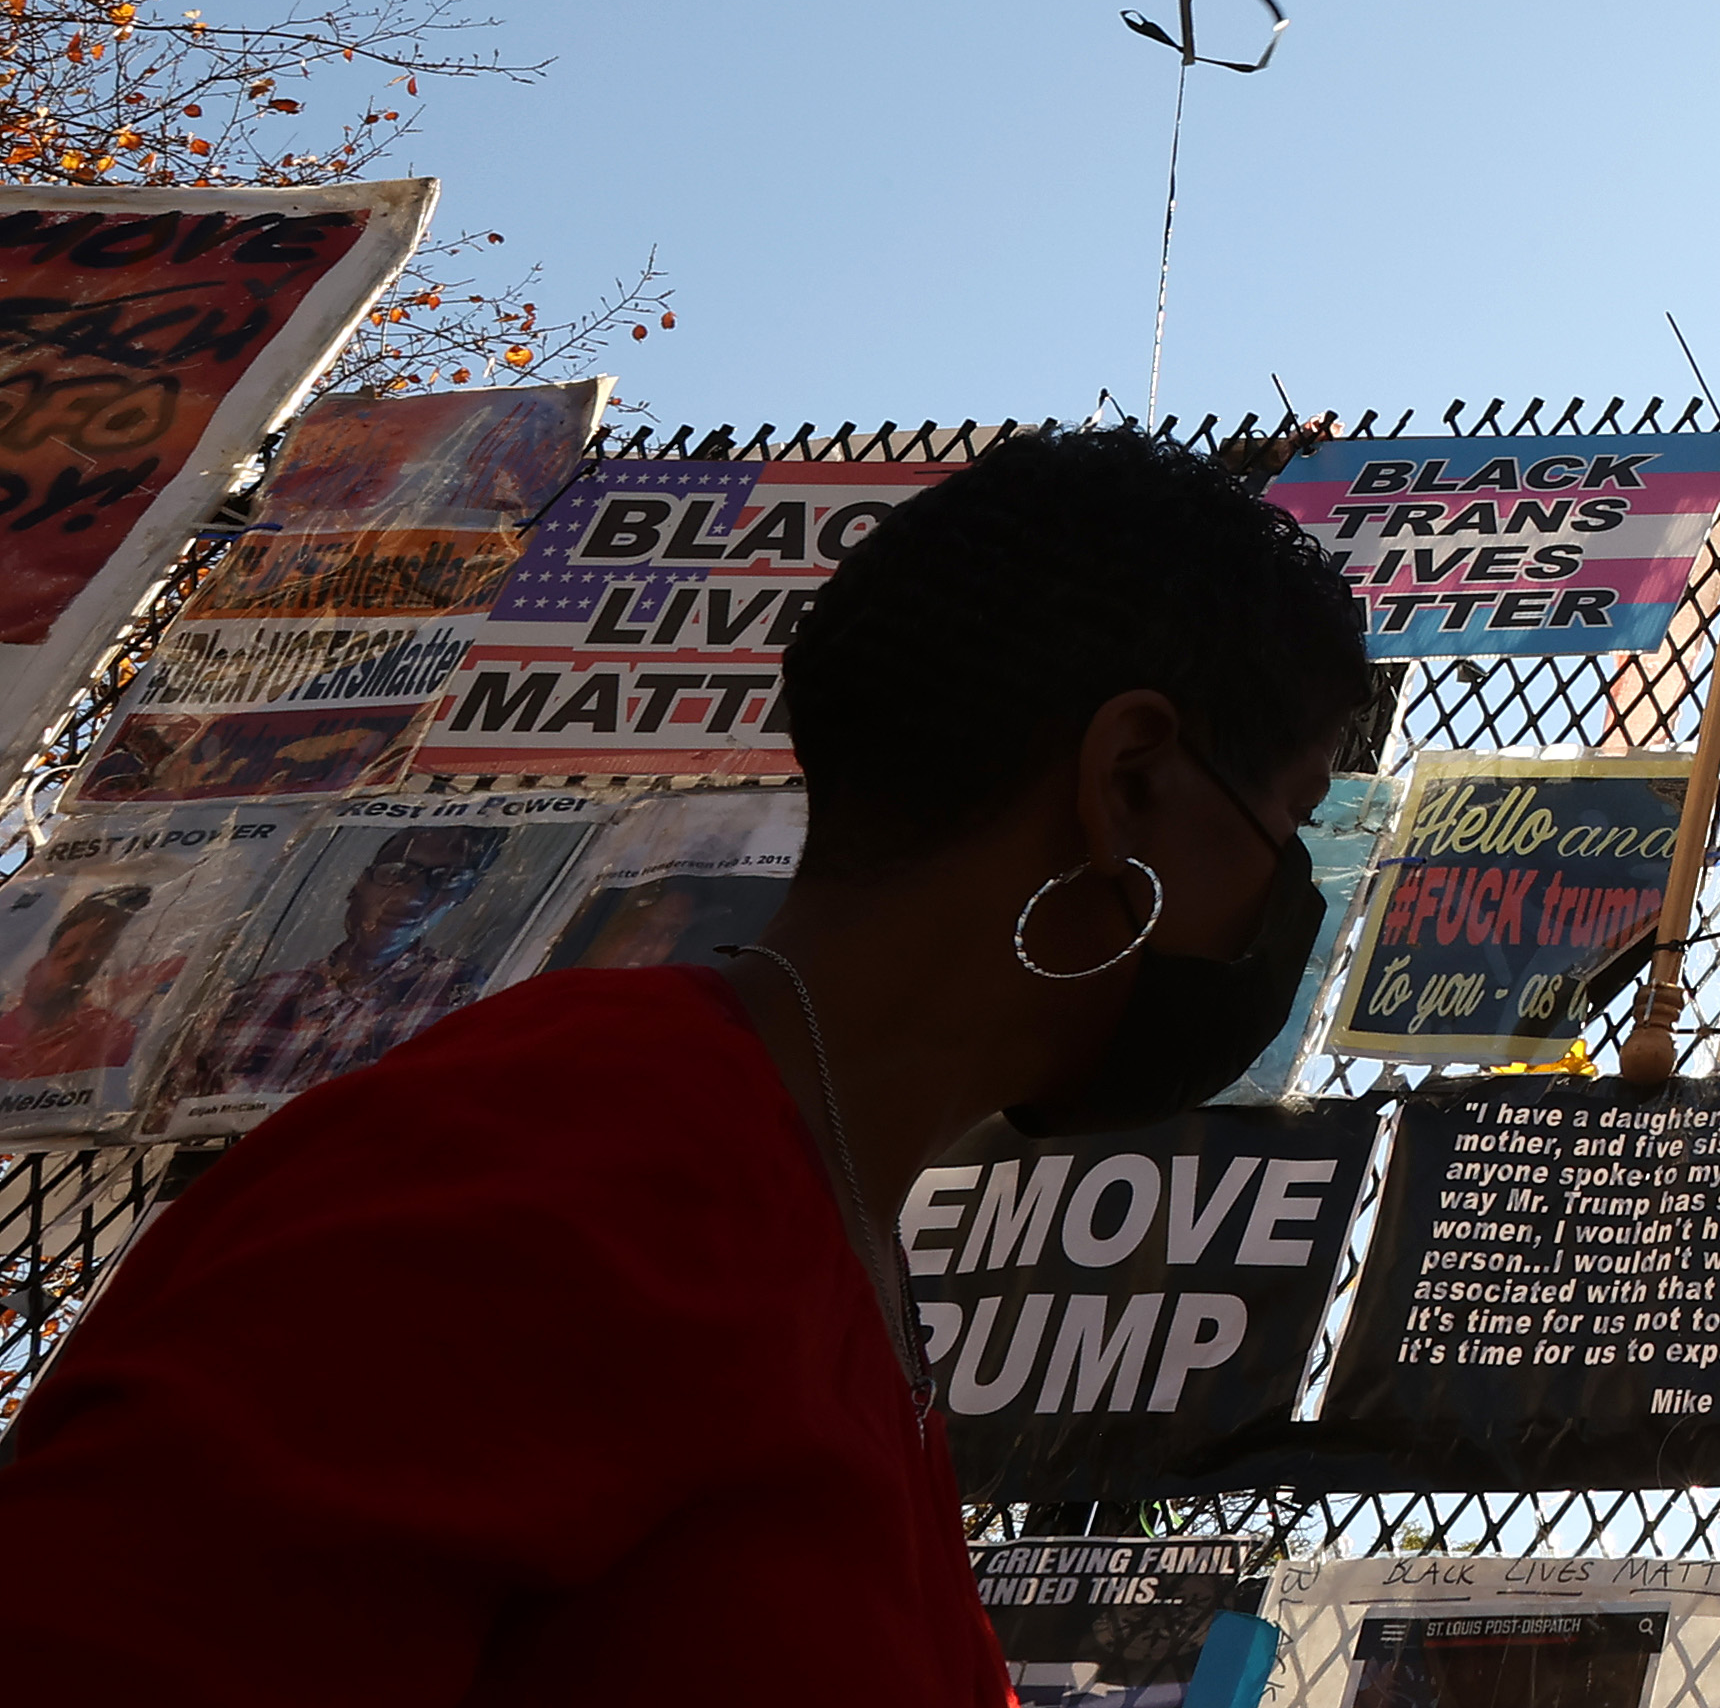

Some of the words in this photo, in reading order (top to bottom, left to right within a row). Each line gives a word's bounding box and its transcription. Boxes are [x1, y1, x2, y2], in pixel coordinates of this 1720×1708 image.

[1346, 453, 1663, 497] BLACK
[580, 498, 899, 562] BLAC
[1328, 497, 1632, 539] TRANS
[1333, 543, 1584, 585] LIVES
[1363, 589, 1620, 635] ATTER
[1413, 783, 1558, 861] Hello
[1384, 865, 1539, 948] #FUCK
[1369, 955, 1411, 1016] to
[1407, 972, 1487, 1035] you
[900, 1154, 1340, 1277] EMOVE
[1439, 1188, 1497, 1215] way
[1506, 1188, 1549, 1213] Mr.
[1563, 1191, 1650, 1220] Trump
[1659, 1188, 1705, 1213] has
[1431, 1218, 1542, 1248] women,
[1553, 1219, 1564, 1244] I
[1575, 1217, 1692, 1246] wouldn't
[1414, 1278, 1576, 1304] associated
[1586, 1277, 1648, 1304] with
[1656, 1275, 1716, 1301] that
[1651, 1387, 1713, 1414] Mike
[986, 1547, 1133, 1575] GRIEVING
[1383, 1560, 1475, 1588] BLACK
[1505, 1559, 1595, 1585] LIVES
[1088, 1578, 1182, 1606] THIS...
[1426, 1620, 1447, 1637] ST.
[1449, 1619, 1481, 1635] LOUIS
[1484, 1617, 1582, 1634] POST-DISPATCH
